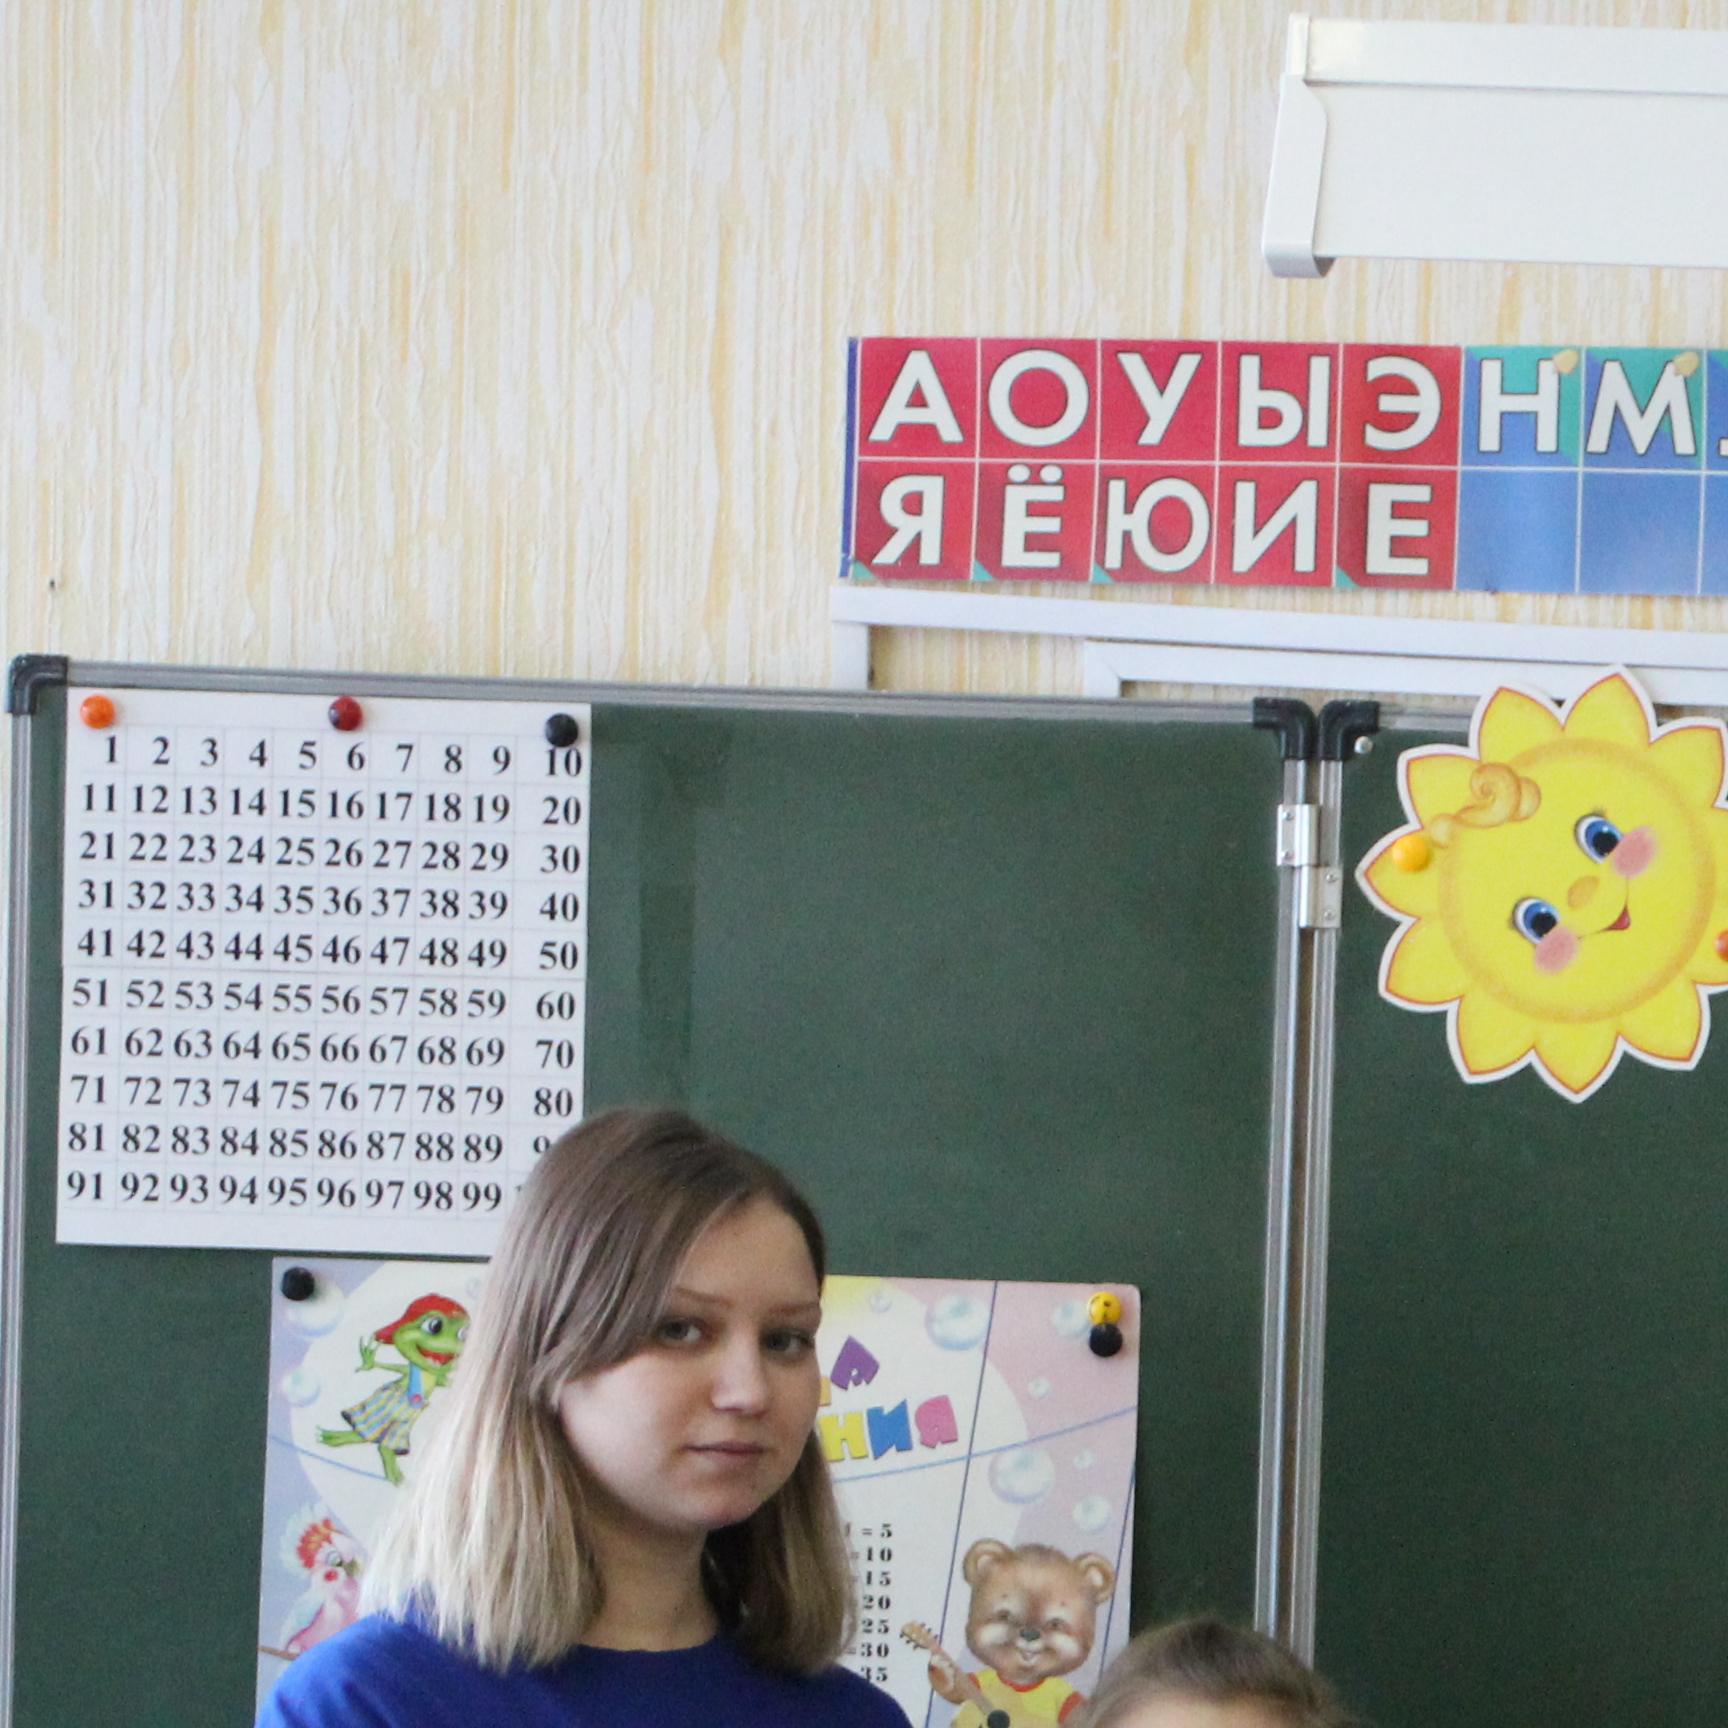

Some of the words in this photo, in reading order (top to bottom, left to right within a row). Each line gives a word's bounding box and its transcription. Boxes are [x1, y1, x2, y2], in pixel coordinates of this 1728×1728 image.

[153, 736, 170, 766] 2
[200, 737, 219, 767] 3
[248, 739, 268, 768] 4
[299, 740, 317, 770] 5
[346, 743, 366, 771] 6
[396, 743, 414, 772] 7
[443, 745, 463, 773] 8
[492, 746, 511, 774] 9
[546, 747, 583, 777] 10
[85, 783, 115, 813] 11
[134, 784, 169, 814] 12
[184, 786, 217, 816] 13
[232, 787, 267, 817] 14
[281, 788, 316, 818] 15
[329, 790, 365, 819] 16
[378, 791, 413, 821] 17
[426, 793, 462, 822] 18
[475, 794, 510, 823] 19
[542, 795, 582, 826] 20
[80, 830, 114, 860] 21
[129, 832, 168, 862] 22
[178, 833, 217, 863] 23
[227, 835, 266, 865] 24
[276, 836, 315, 866] 25
[324, 838, 364, 867] 26
[373, 839, 412, 869] 27
[421, 840, 461, 870] 28
[470, 842, 509, 871] 29
[540, 844, 581, 874] 30
[77, 928, 113, 957] 41
[126, 929, 166, 959] 42
[175, 930, 215, 961] 43
[223, 932, 264, 962] 44
[272, 933, 313, 963] 45
[321, 934, 362, 965] 46
[370, 936, 410, 966] 47
[418, 937, 459, 967] 48
[467, 939, 508, 968] 49
[539, 941, 579, 971] 50
[71, 1027, 106, 1055] 61
[124, 1028, 163, 1057] 62
[173, 1029, 213, 1059] 63
[222, 1031, 262, 1060] 64
[271, 1032, 311, 1062] 65
[320, 1034, 360, 1063] 66
[368, 1035, 408, 1064] 67
[417, 1036, 457, 1066] 68
[465, 1038, 505, 1066] 69
[535, 1039, 575, 1069] 70
[68, 1123, 103, 1152] 81
[122, 1124, 161, 1154] 82
[171, 1126, 210, 1155] 83
[220, 1127, 259, 1157] 84
[268, 1128, 309, 1158] 85
[317, 1130, 358, 1159] 86
[366, 1131, 406, 1161] 87
[414, 1132, 454, 1162] 88
[463, 1134, 503, 1163] 89
[67, 1171, 102, 1200] 91
[120, 1172, 159, 1202] 92
[169, 1174, 209, 1204] 93
[218, 1175, 258, 1205] 94
[267, 1177, 308, 1207] 95
[316, 1178, 356, 1208] 96
[365, 1180, 405, 1209] 97
[413, 1181, 453, 1210] 98
[462, 1182, 502, 1211] 99
